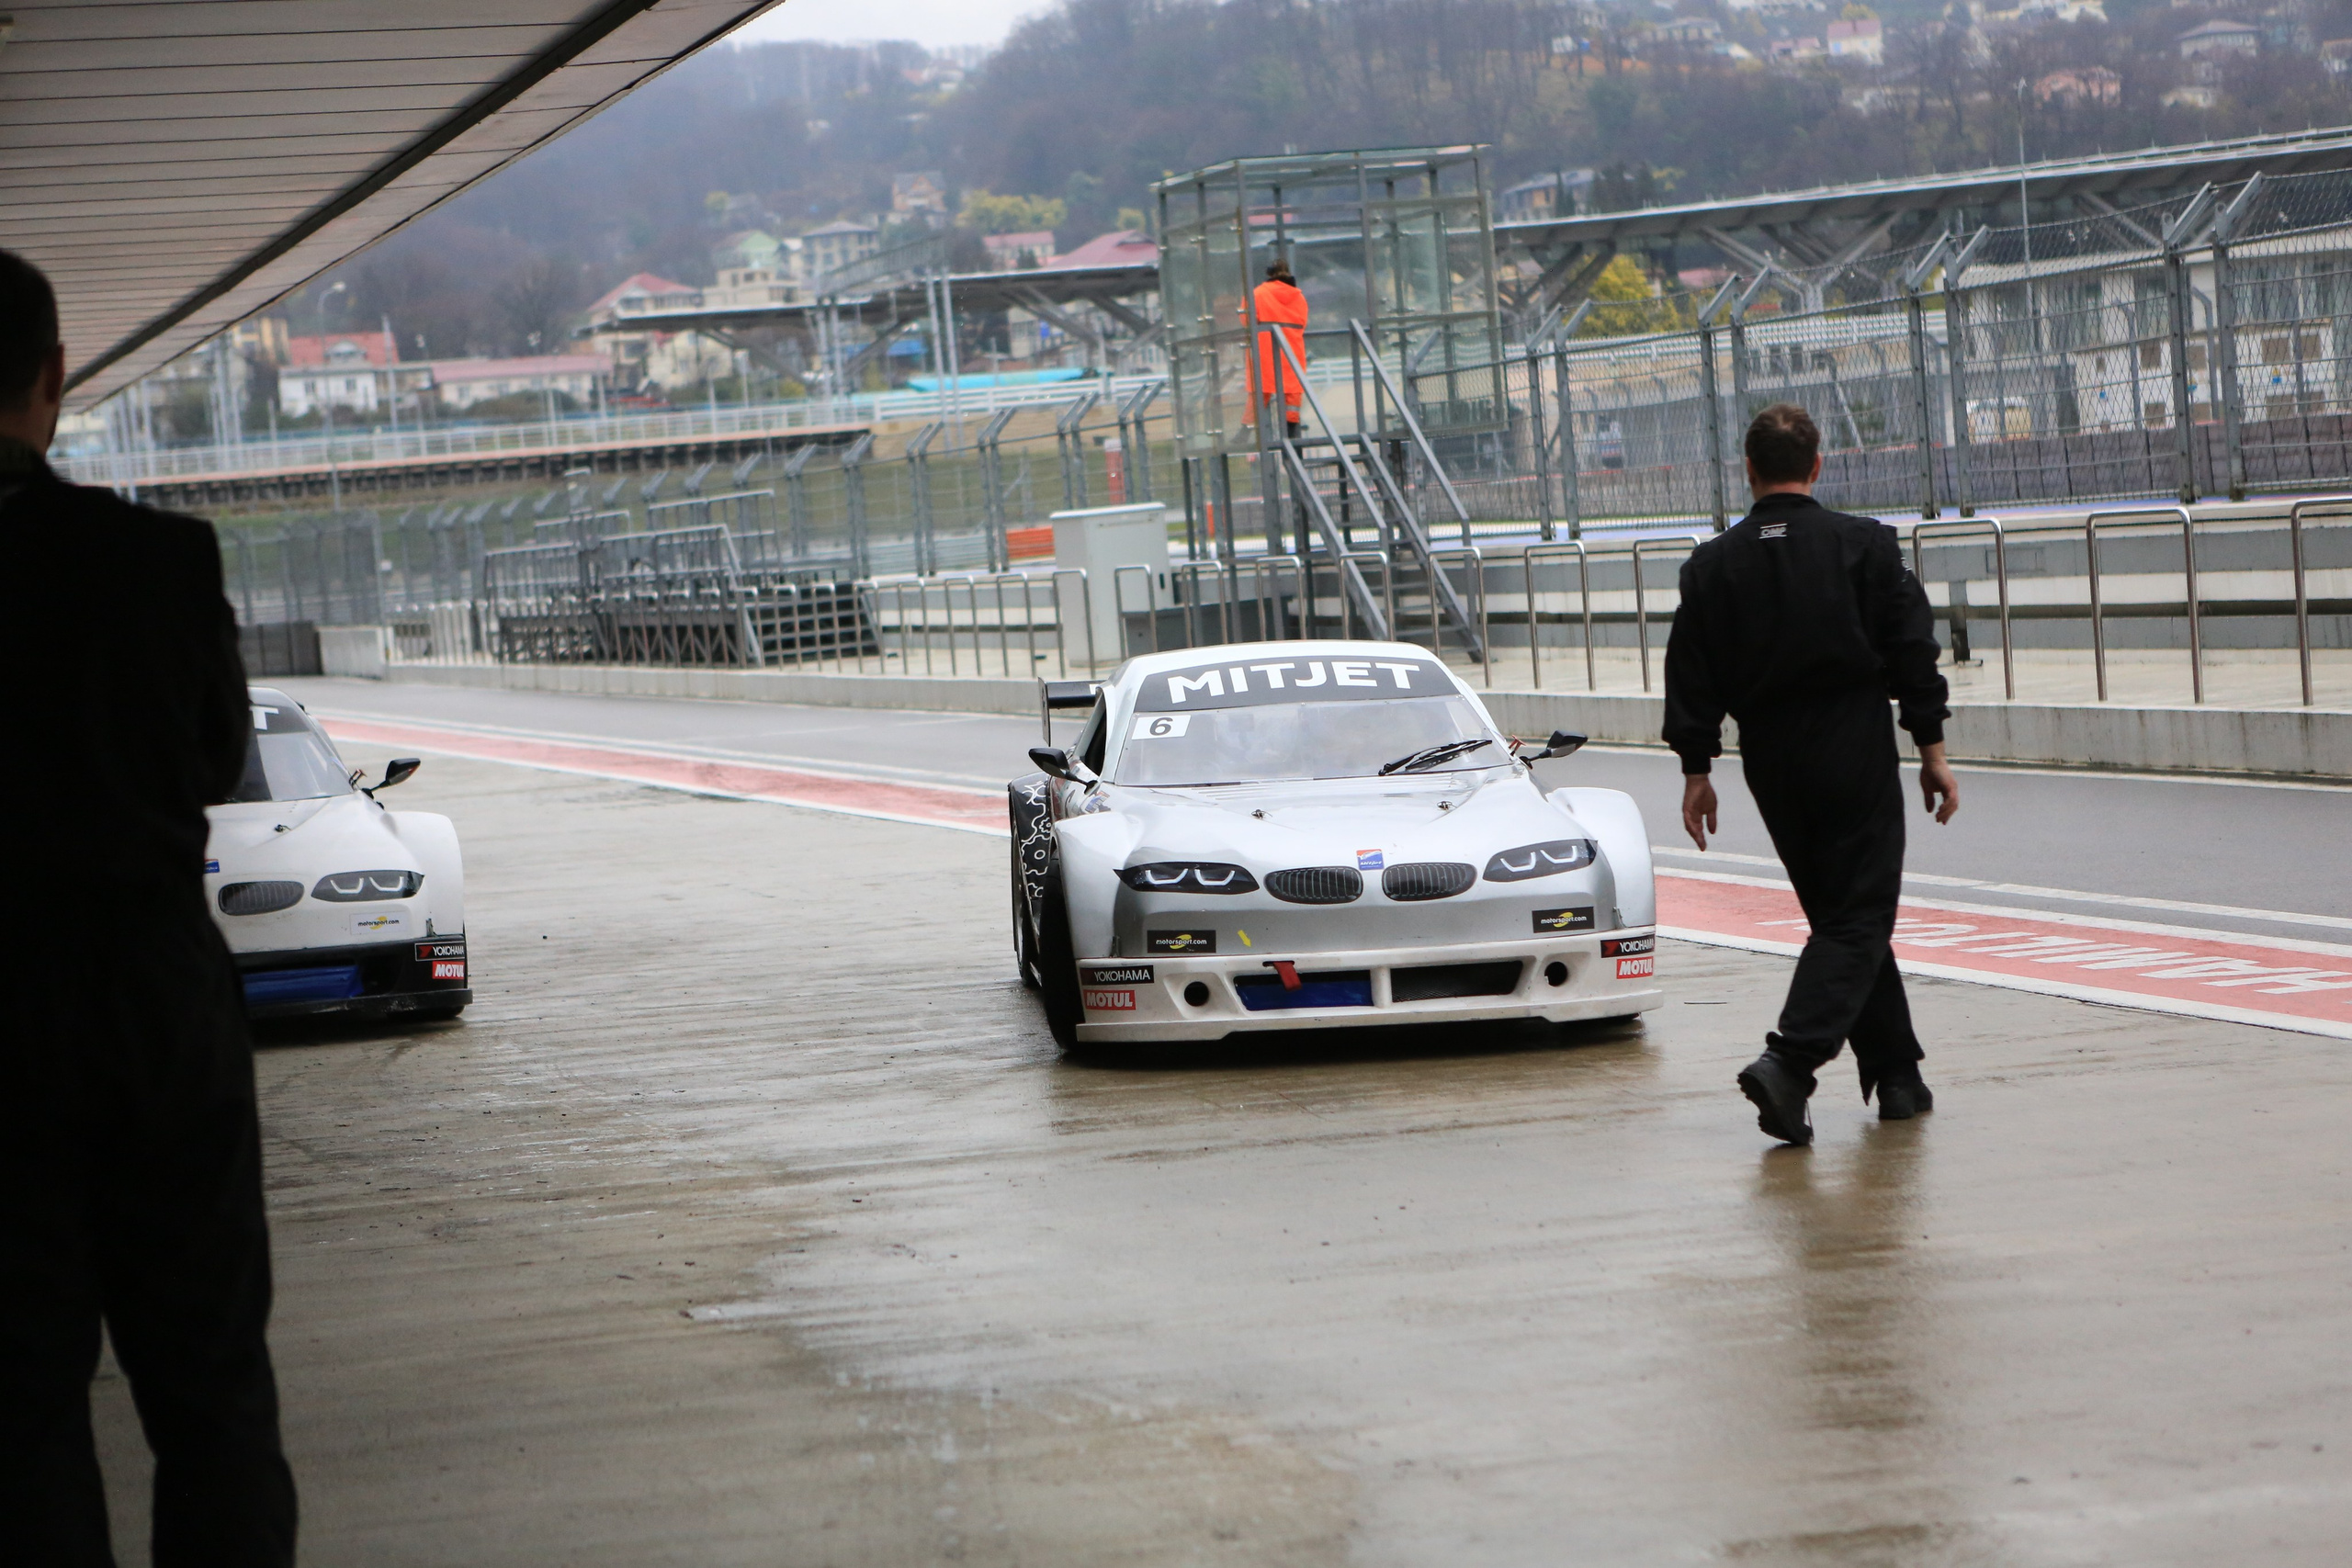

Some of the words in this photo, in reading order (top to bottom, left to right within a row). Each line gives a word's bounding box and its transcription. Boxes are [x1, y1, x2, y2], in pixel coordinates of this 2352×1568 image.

[1760, 526, 1786, 536] OMP
[1167, 661, 1420, 704] MITJET
[1149, 717, 1171, 736] 6
[357, 919, 400, 927] motorsport.com
[1541, 915, 1587, 925] motorsport.com
[1156, 938, 1207, 946] motorsport.com
[1094, 969, 1150, 982] YOKOHAMA
[1086, 992, 1133, 1008] MOTUL
